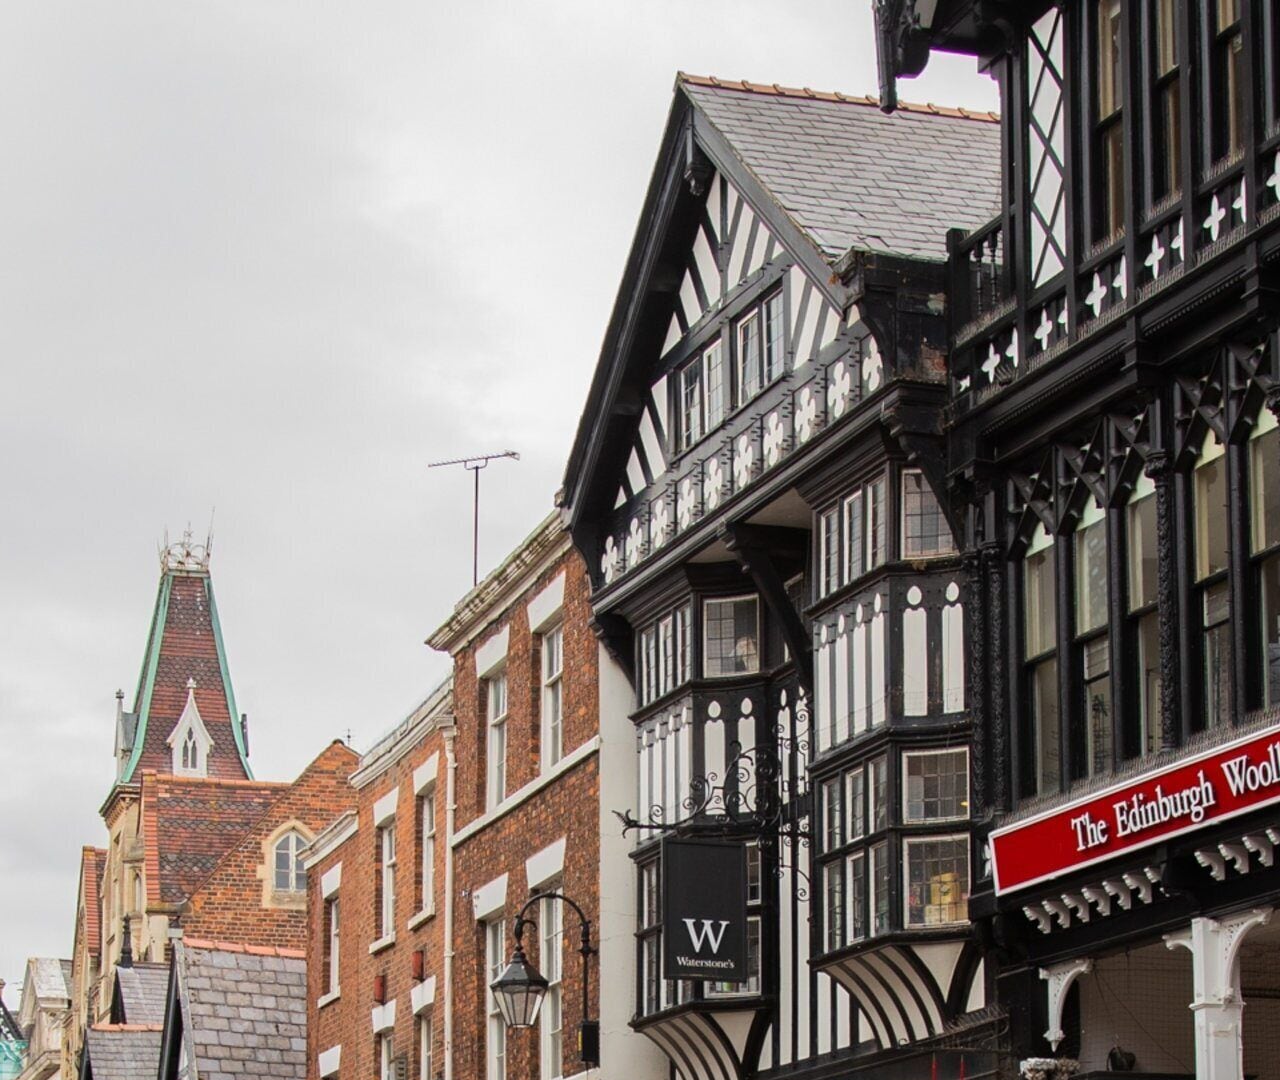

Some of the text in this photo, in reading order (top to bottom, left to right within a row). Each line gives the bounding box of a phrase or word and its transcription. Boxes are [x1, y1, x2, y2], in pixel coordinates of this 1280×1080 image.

[1071, 812, 1108, 853] The
[1113, 770, 1216, 838] Edinburgh
[681, 917, 730, 955] W
[676, 956, 736, 970] Waterstone's
